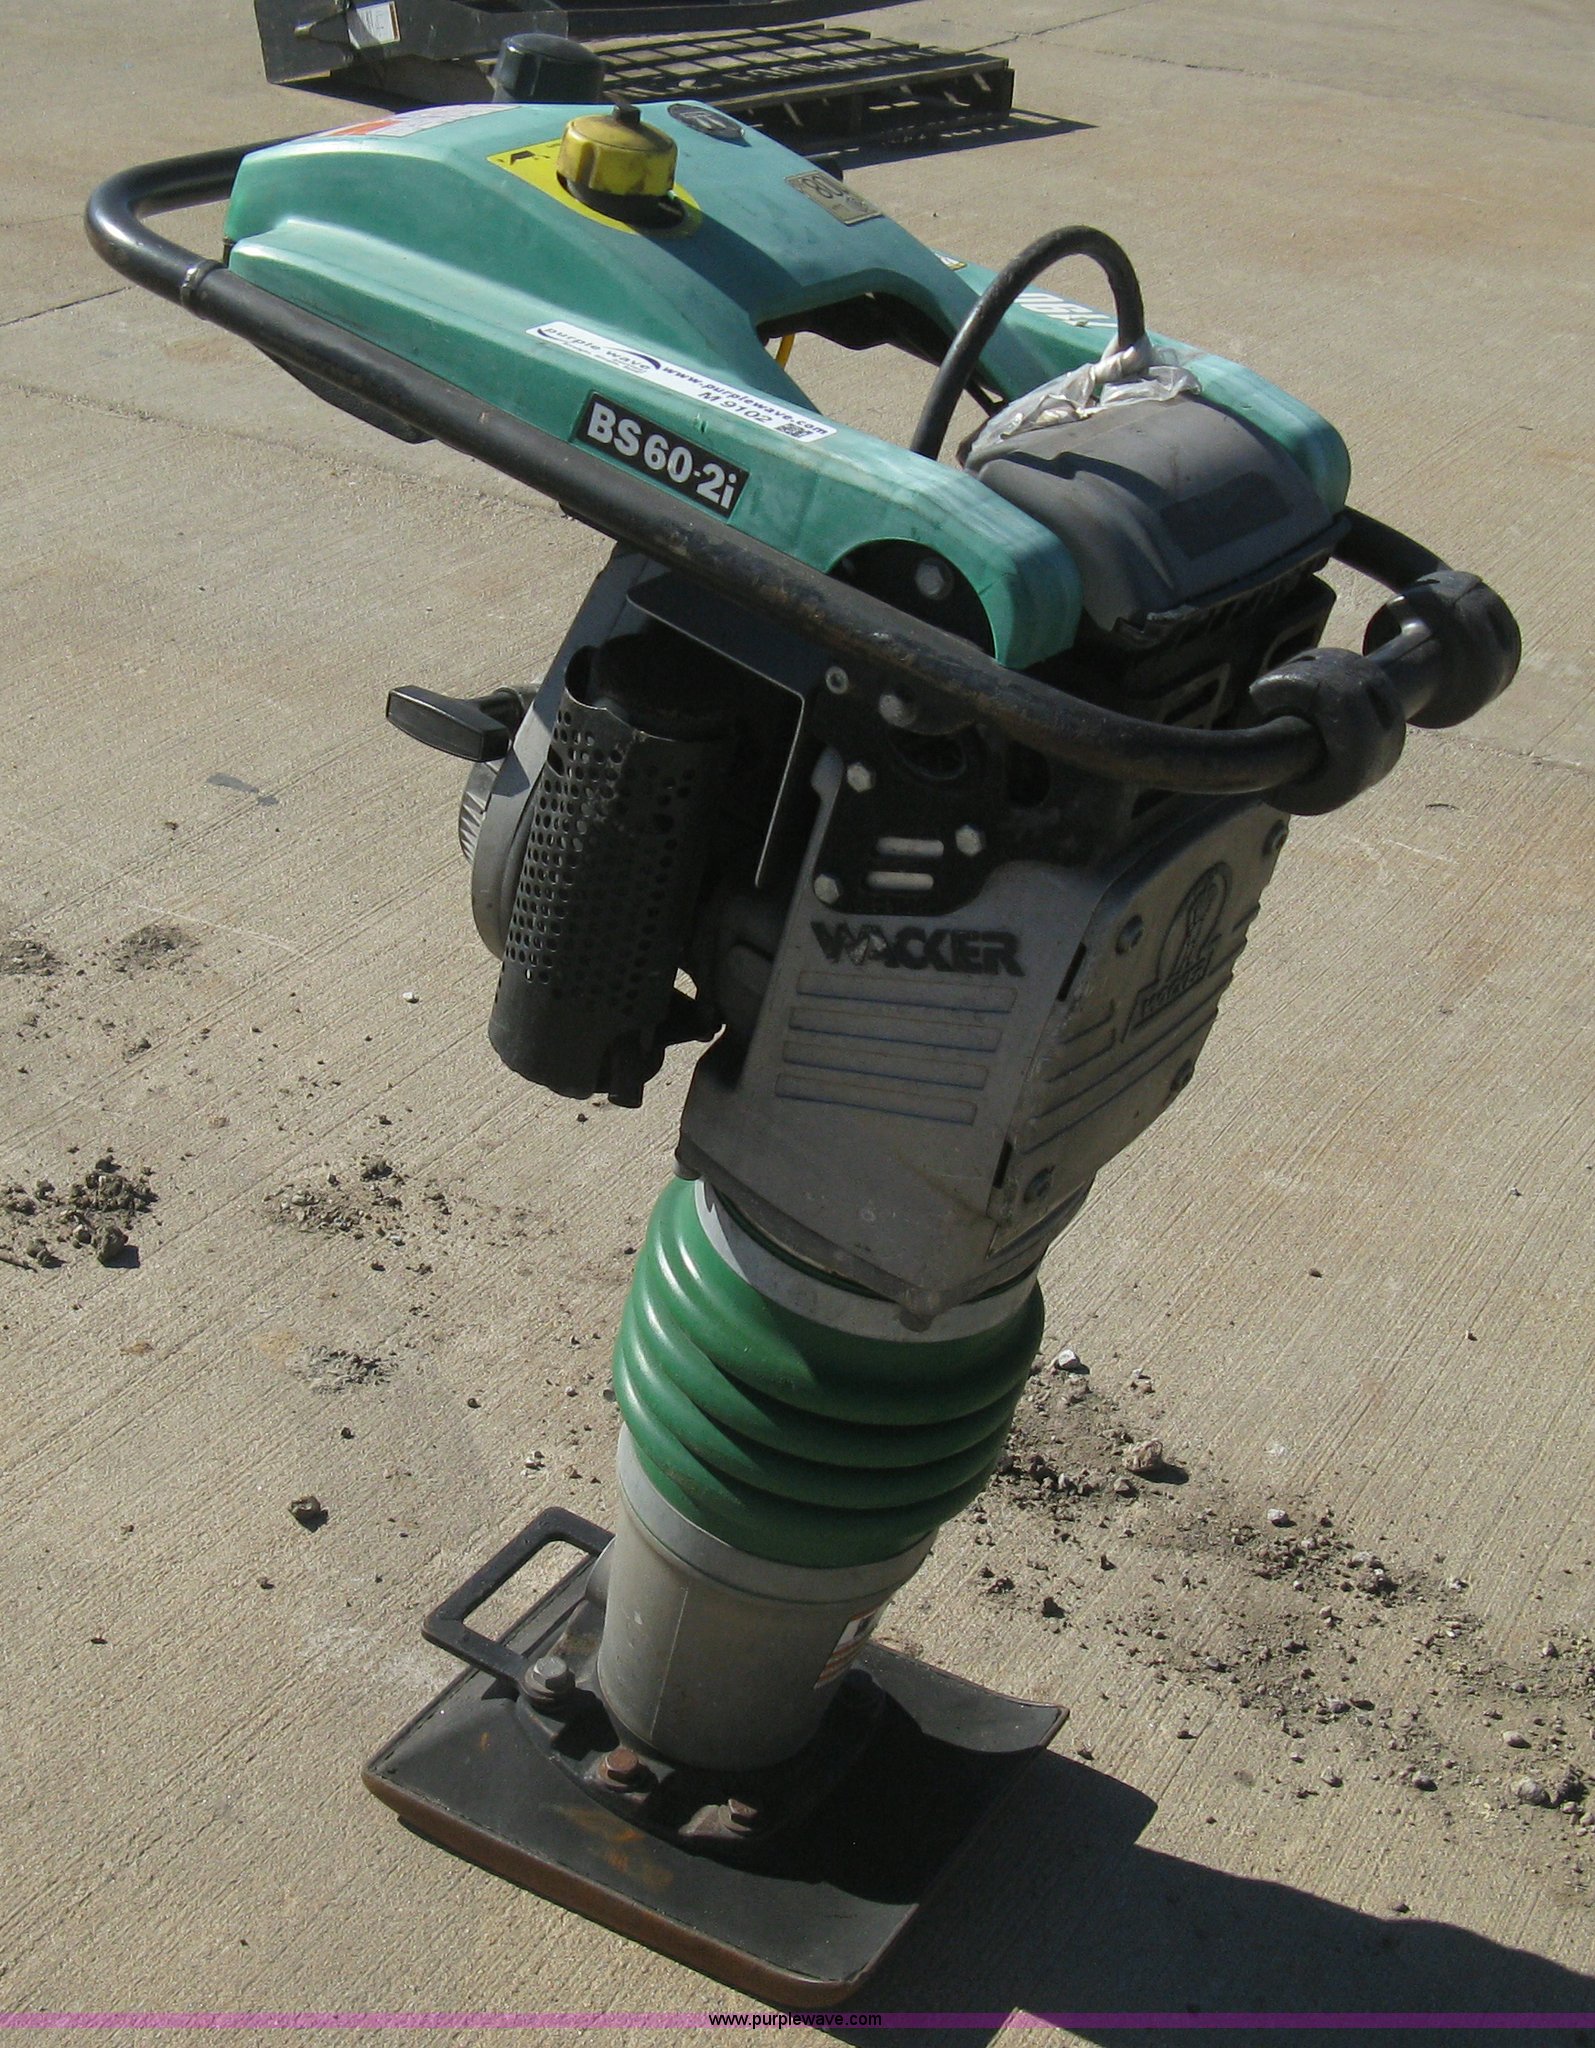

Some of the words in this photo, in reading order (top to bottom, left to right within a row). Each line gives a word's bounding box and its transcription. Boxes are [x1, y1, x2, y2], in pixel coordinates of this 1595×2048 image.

[544, 327, 601, 350] purple
[605, 350, 651, 370] wave
[662, 365, 829, 435] www.purplewave.com
[720, 400, 773, 423] 9102
[810, 921, 1026, 977] WACKER
